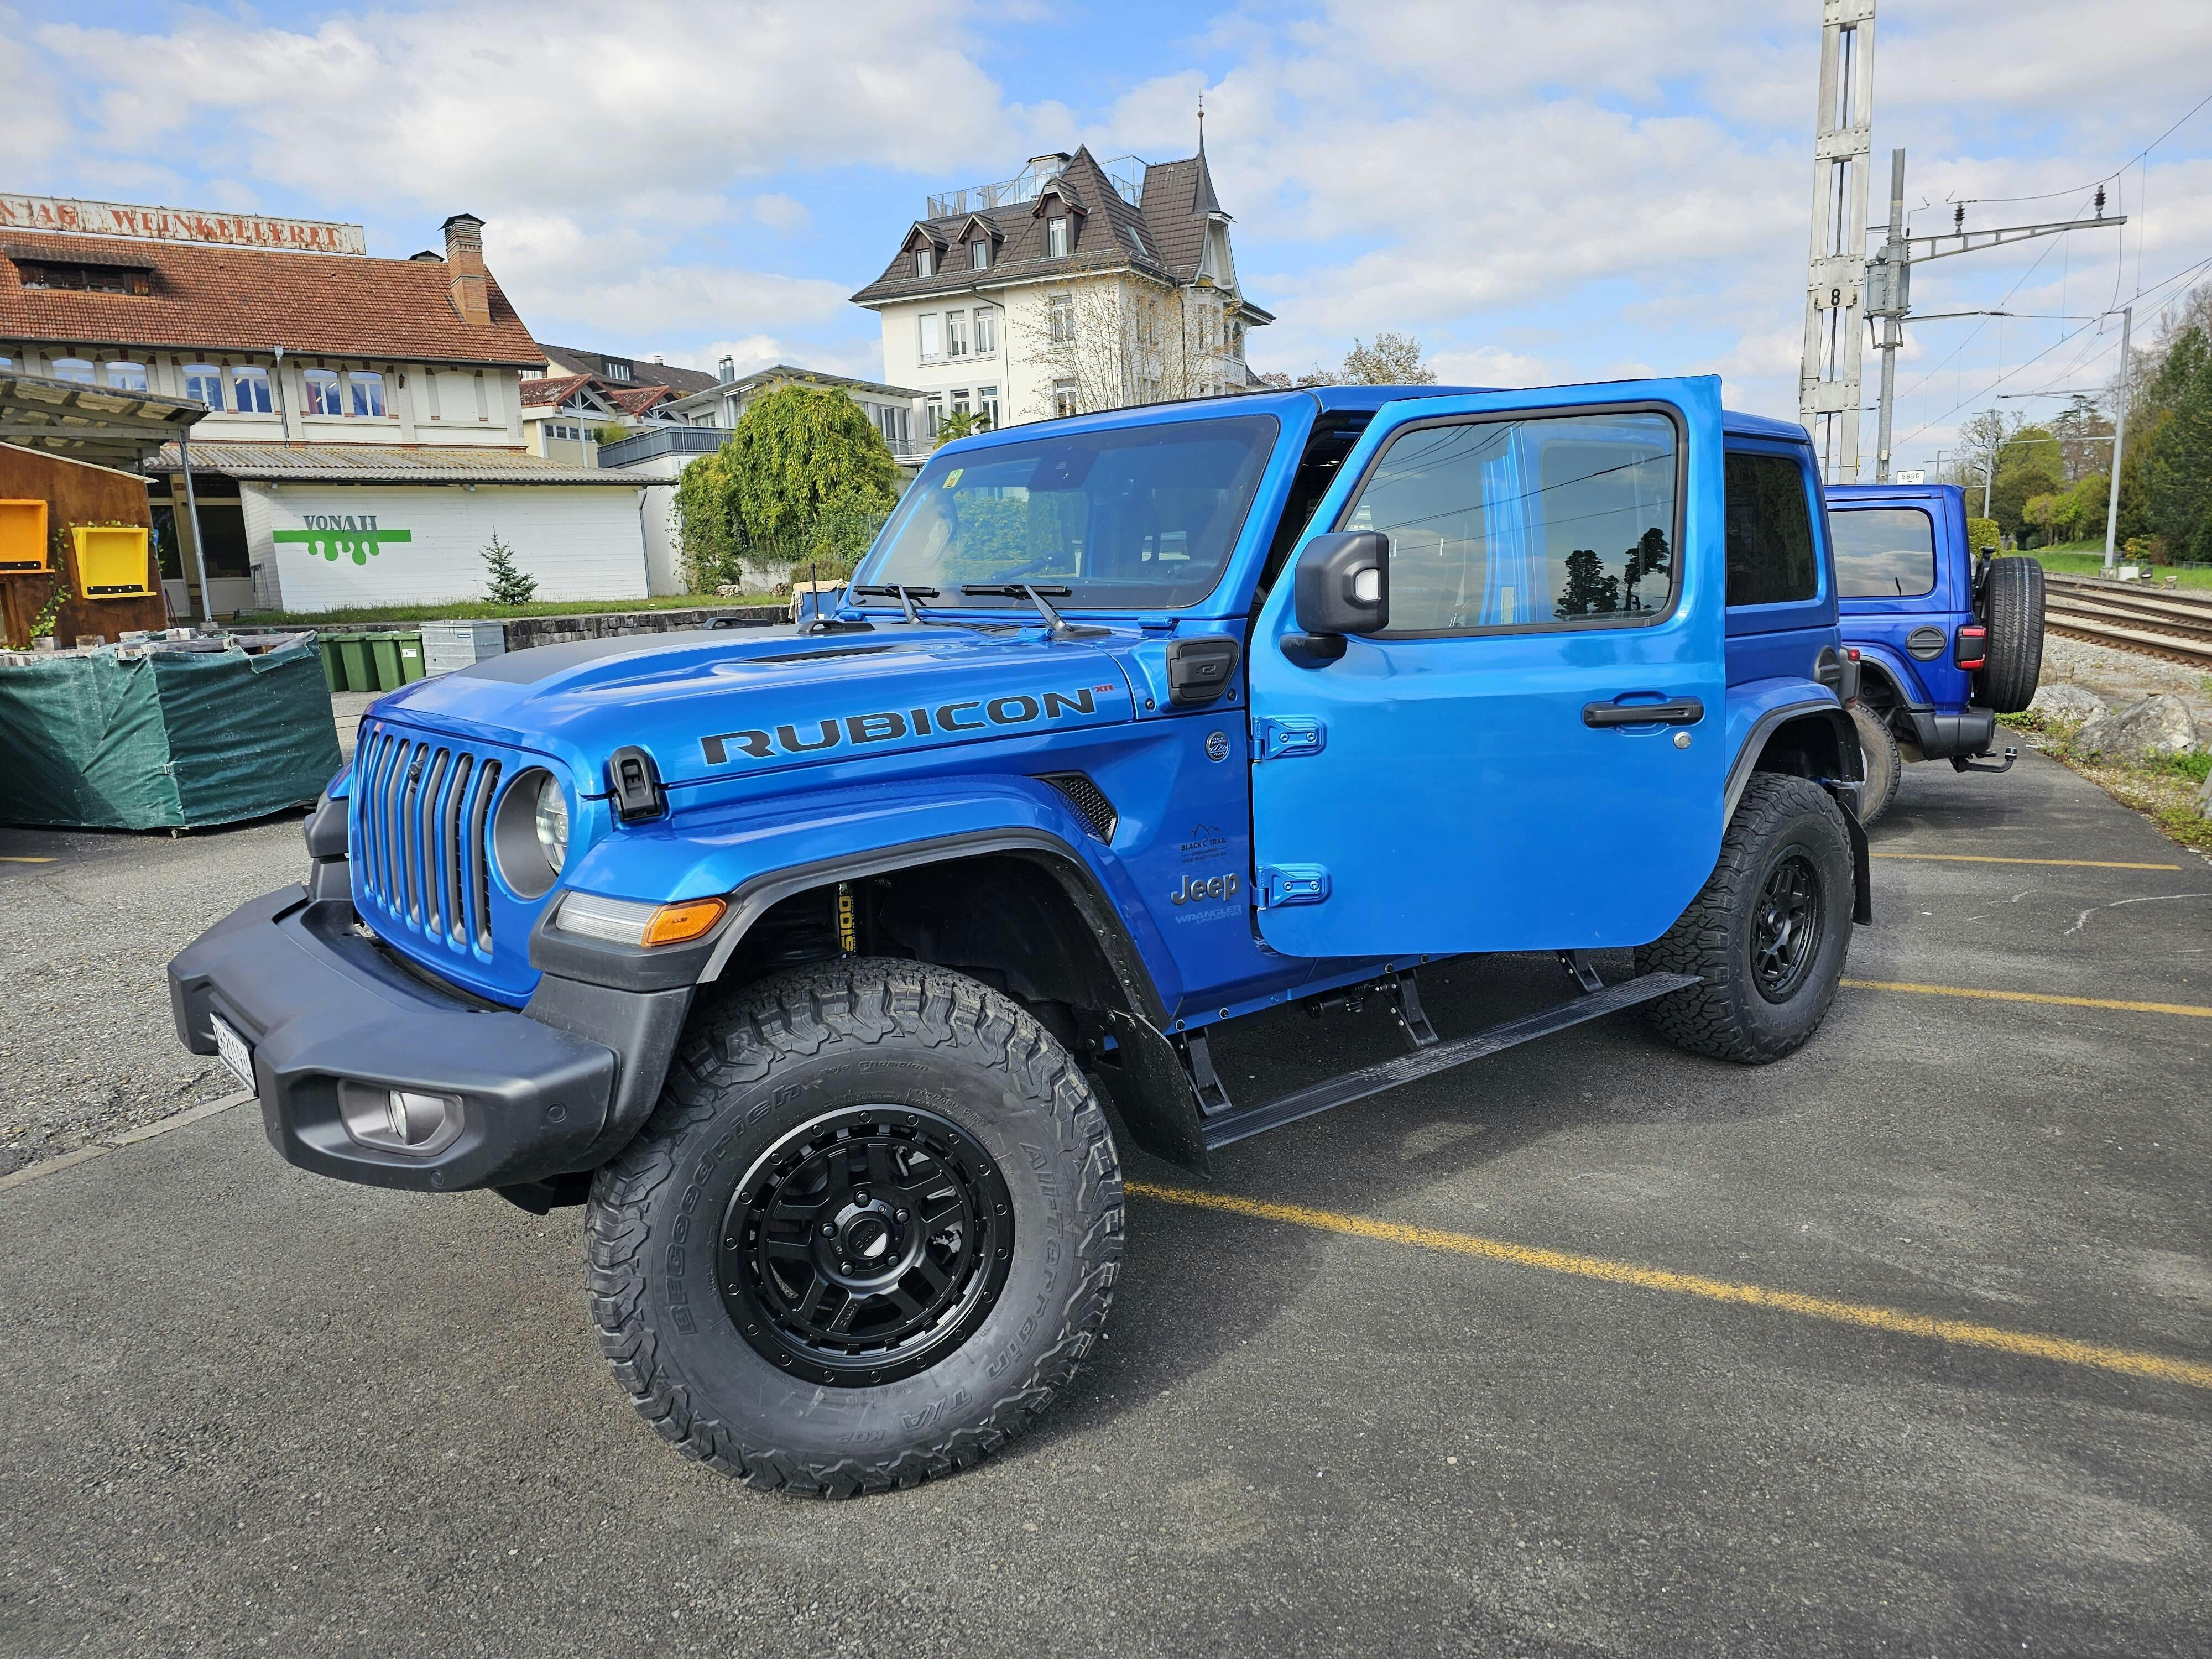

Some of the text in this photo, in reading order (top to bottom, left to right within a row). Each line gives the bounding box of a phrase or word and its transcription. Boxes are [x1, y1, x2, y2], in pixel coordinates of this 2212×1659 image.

[34, 203, 78, 226] AG
[1830, 288, 1840, 306] 8
[302, 515, 378, 534] VONAH
[699, 684, 1115, 766] RUBICON XR
[1181, 837, 1227, 851] BLACK TRAIL
[1171, 872, 1240, 905] Jeep
[839, 895, 854, 952] 5100
[1175, 904, 1242, 924] WRANGLER
[1196, 911, 1242, 924] UNLIMITED
[858, 1060, 929, 1072] Champion
[665, 1082, 803, 1336] BFGoodrich
[985, 1142, 1064, 1381] All-Terrain
[901, 1386, 973, 1431] T/A
